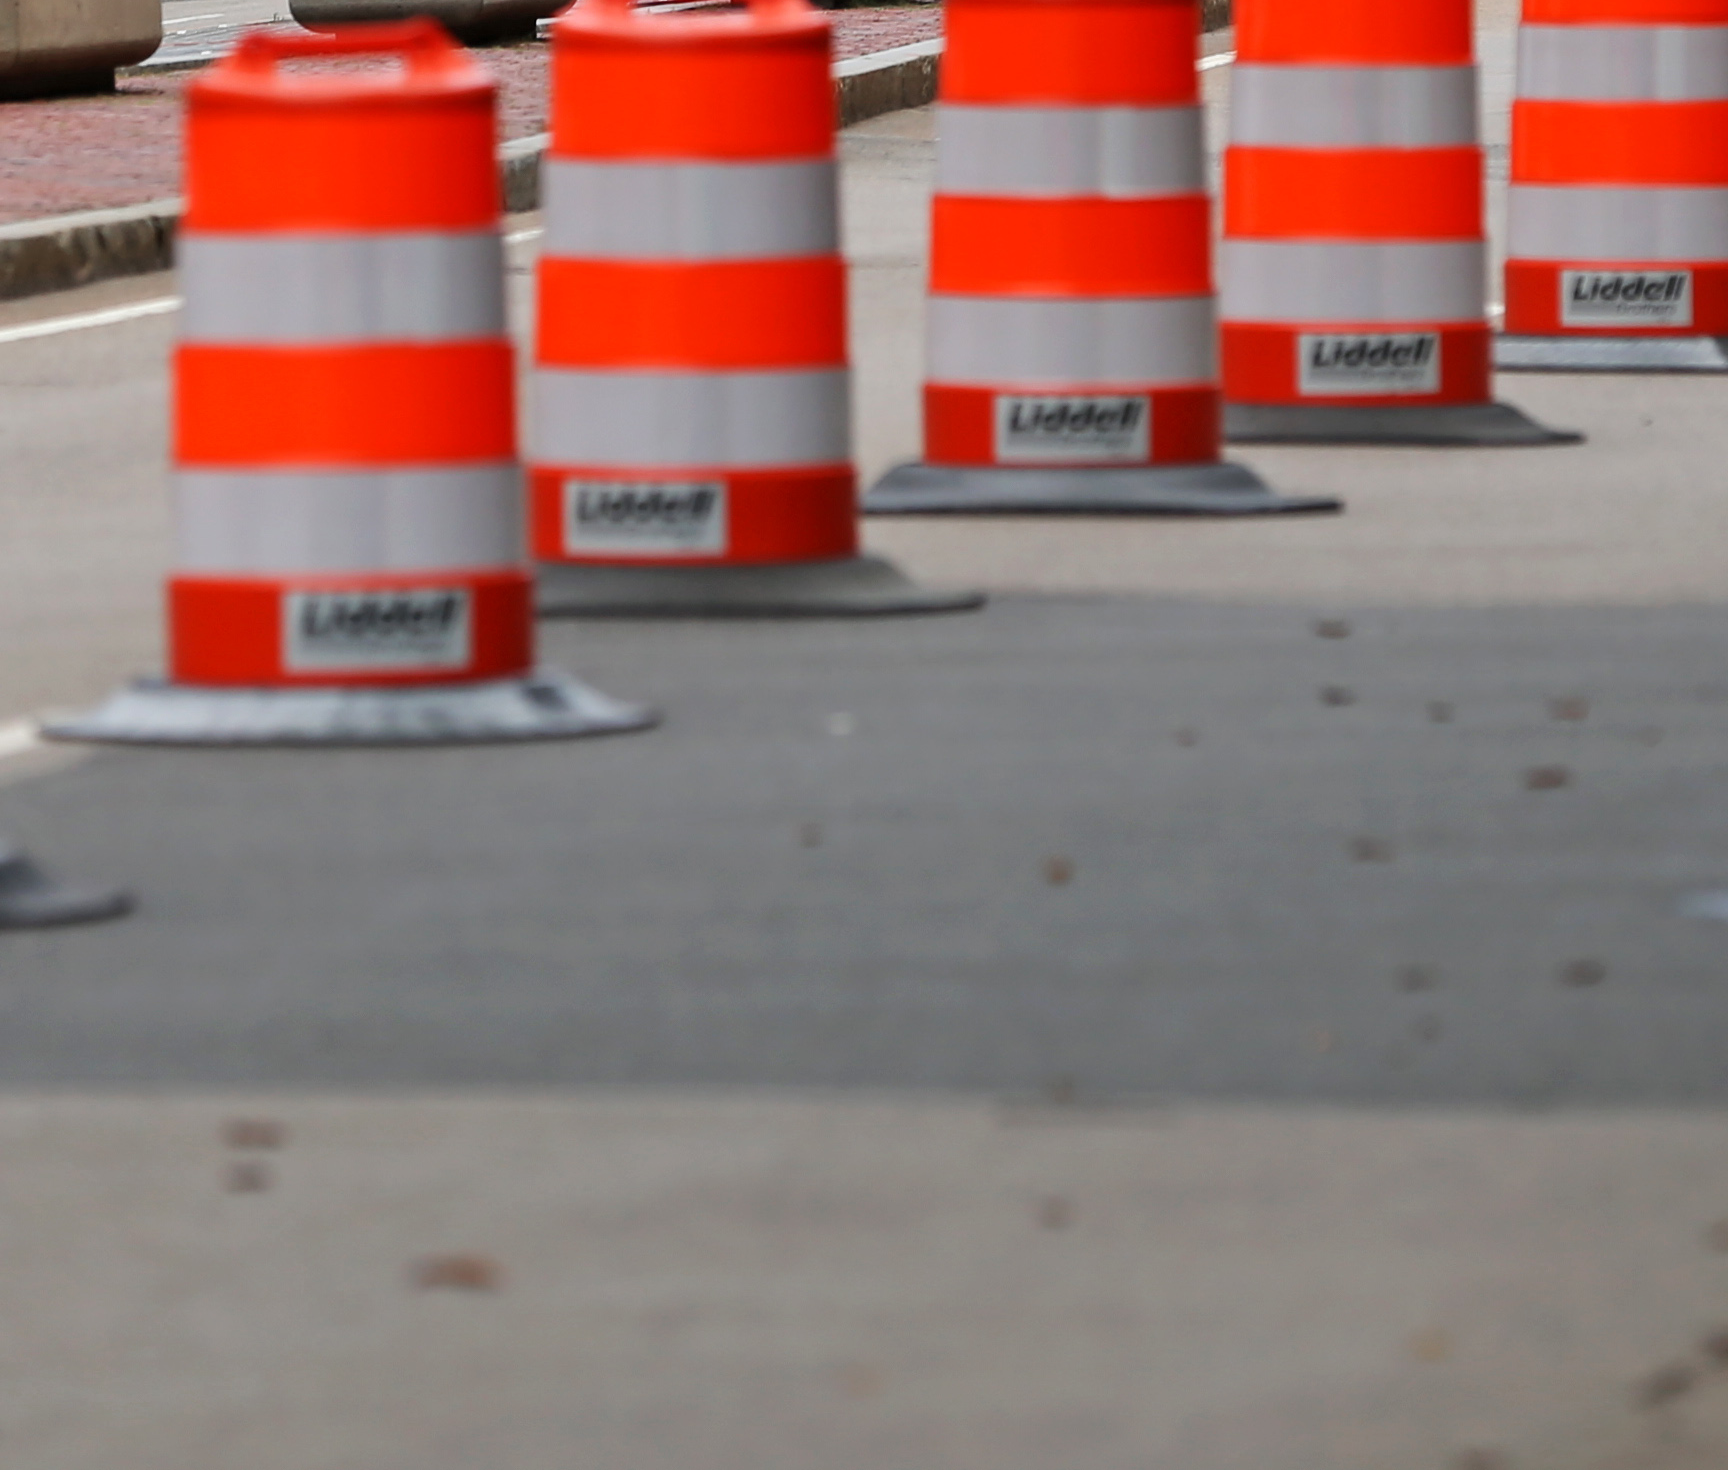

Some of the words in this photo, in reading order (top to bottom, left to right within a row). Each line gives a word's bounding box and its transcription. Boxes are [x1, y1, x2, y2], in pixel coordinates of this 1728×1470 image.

[1574, 275, 1687, 301] Liddell
[1312, 338, 1434, 368] Liddell
[1009, 401, 1142, 433] Liddell
[577, 488, 714, 522] Liddell
[301, 595, 456, 638] Liddell
